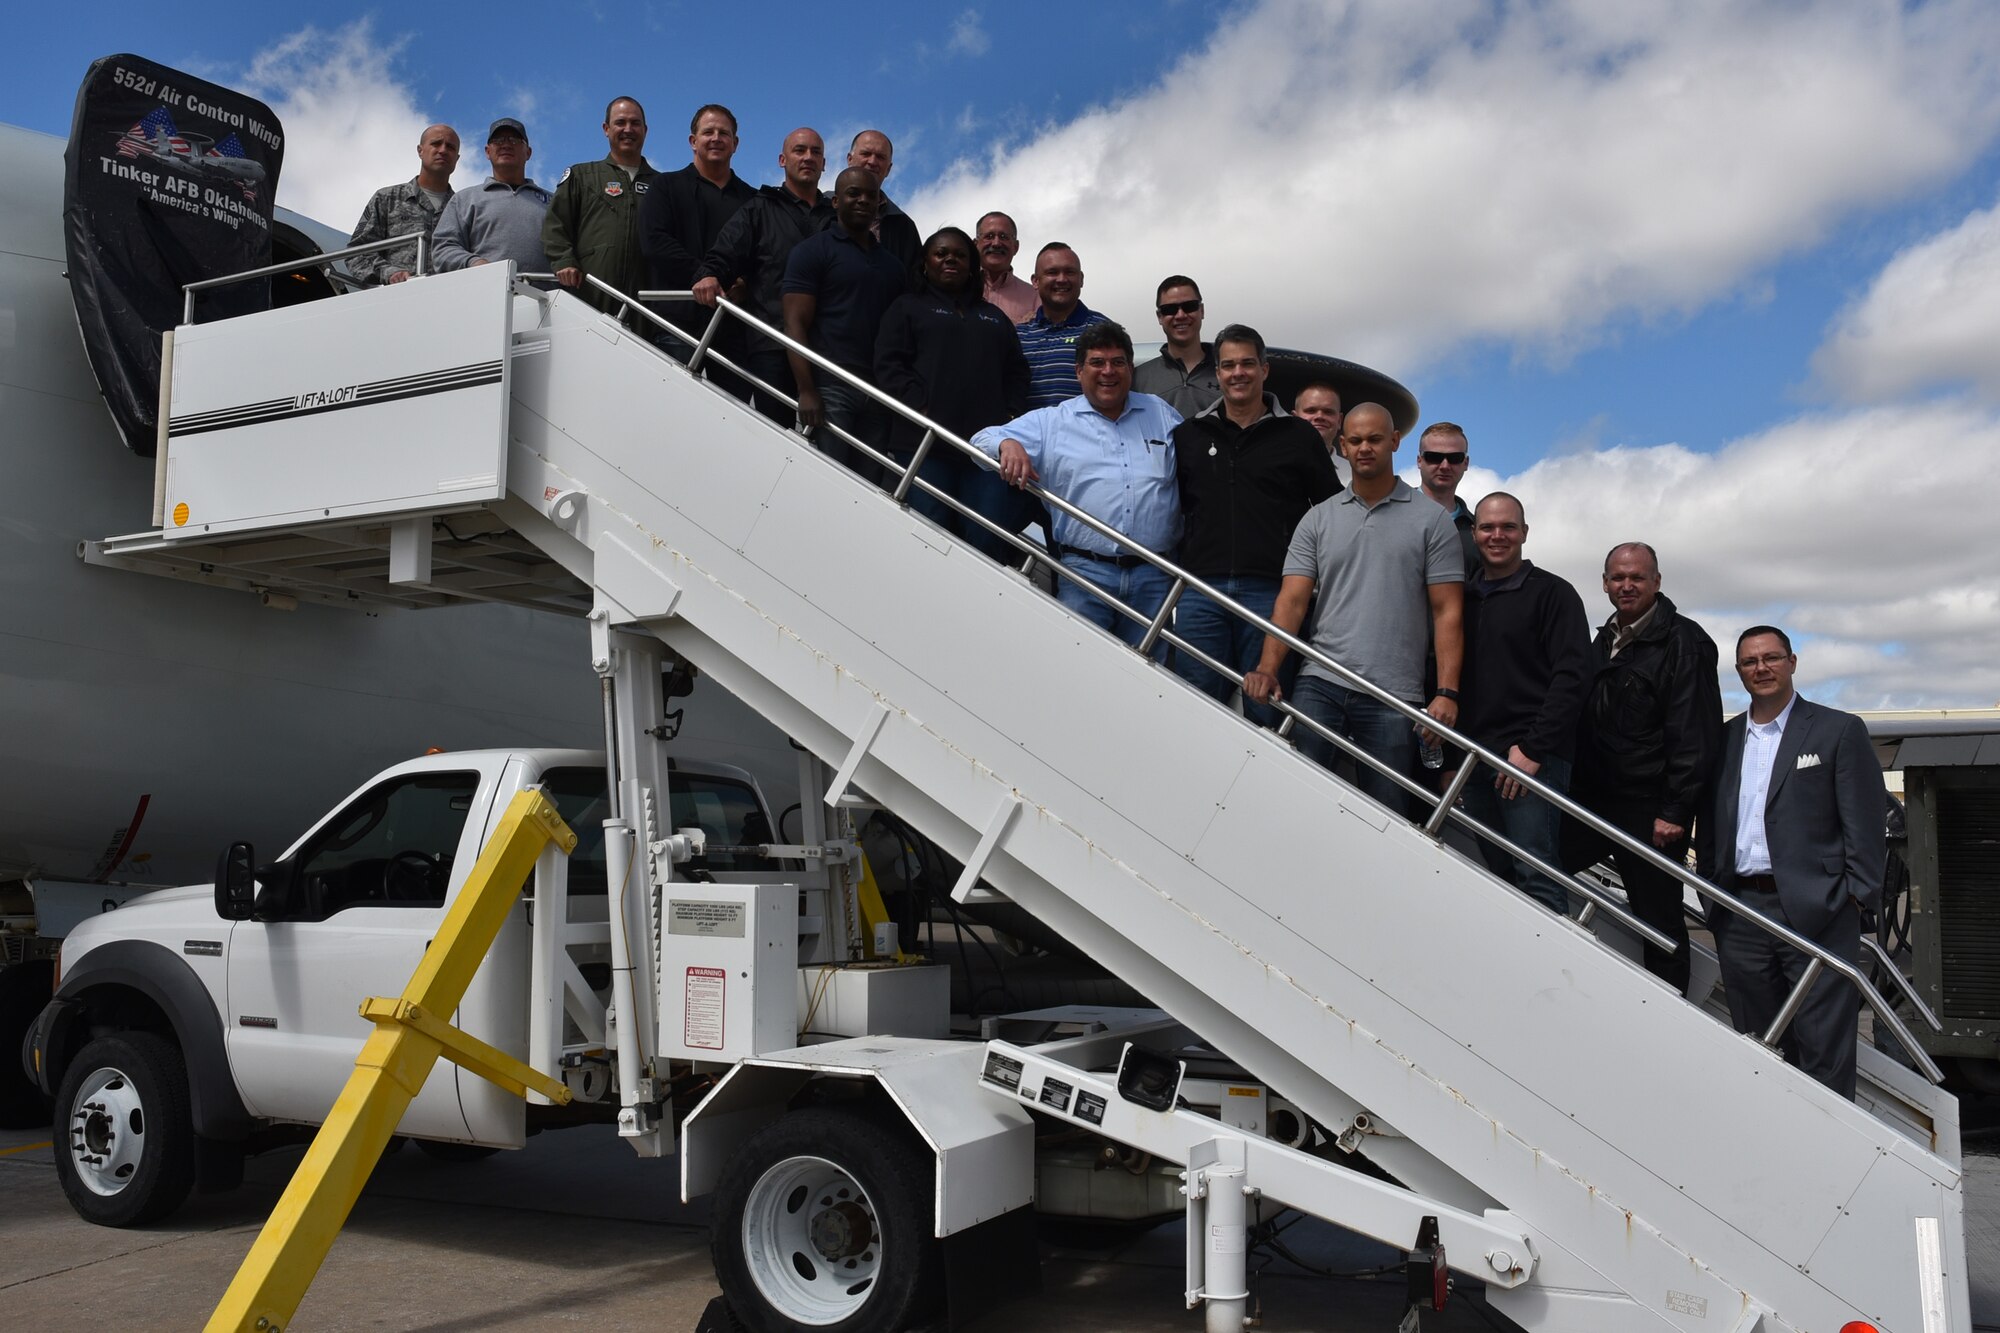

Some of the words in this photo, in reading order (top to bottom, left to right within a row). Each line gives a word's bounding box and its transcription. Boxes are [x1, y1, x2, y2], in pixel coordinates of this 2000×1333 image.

[113, 66, 157, 97] 552d
[157, 84, 182, 106] Air
[186, 94, 244, 129] Control
[248, 118, 282, 151] Wing
[100, 156, 160, 187] Tinker
[165, 175, 199, 199] AFB
[204, 188, 268, 230] Oklahoma
[694, 968, 722, 976] WARNING
[1672, 1298, 1700, 1308] REMOVAL
[1688, 1296, 1704, 1304] CASE
[1690, 1308, 1706, 1318] ONLY
